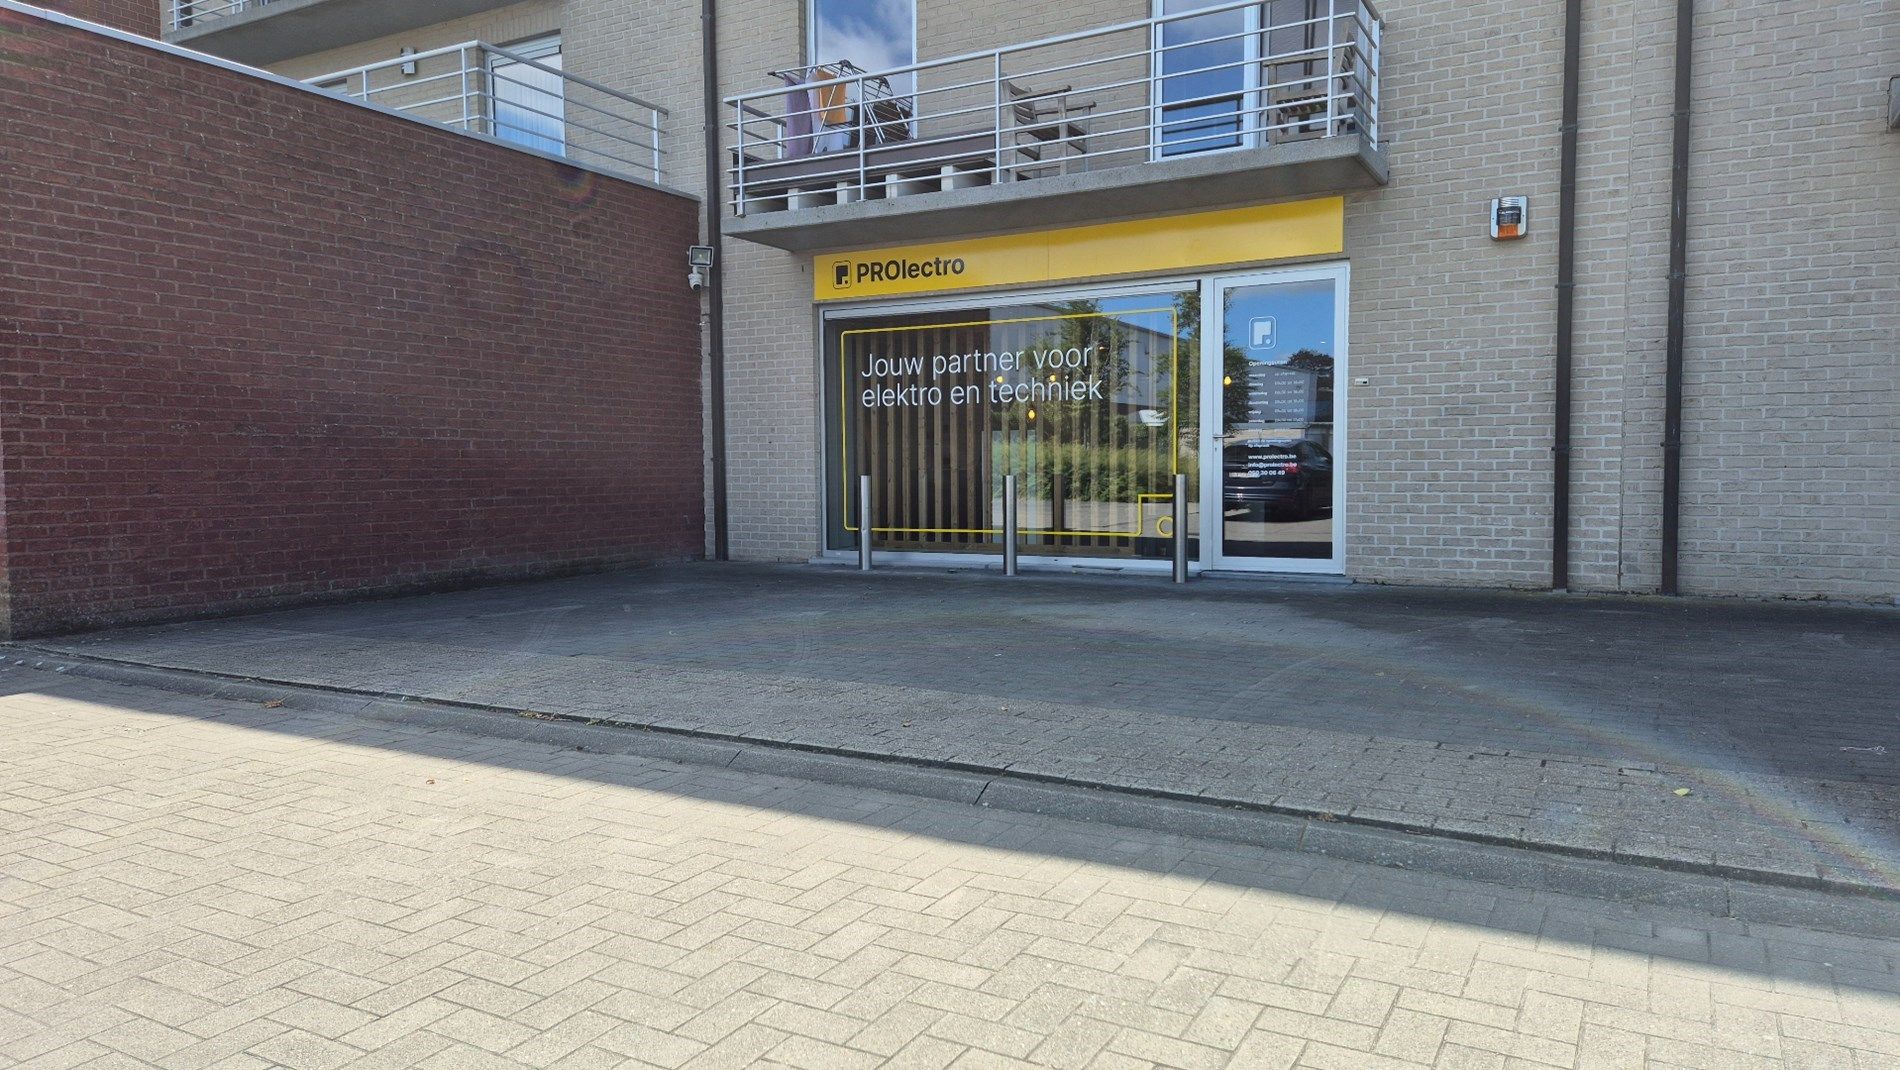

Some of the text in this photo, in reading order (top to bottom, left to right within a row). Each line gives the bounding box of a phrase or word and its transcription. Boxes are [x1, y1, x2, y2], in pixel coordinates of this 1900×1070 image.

[856, 257, 965, 283] PROlectro
[861, 346, 1093, 381] Jouw partner voor
[862, 374, 1103, 408] elektro en techniek
